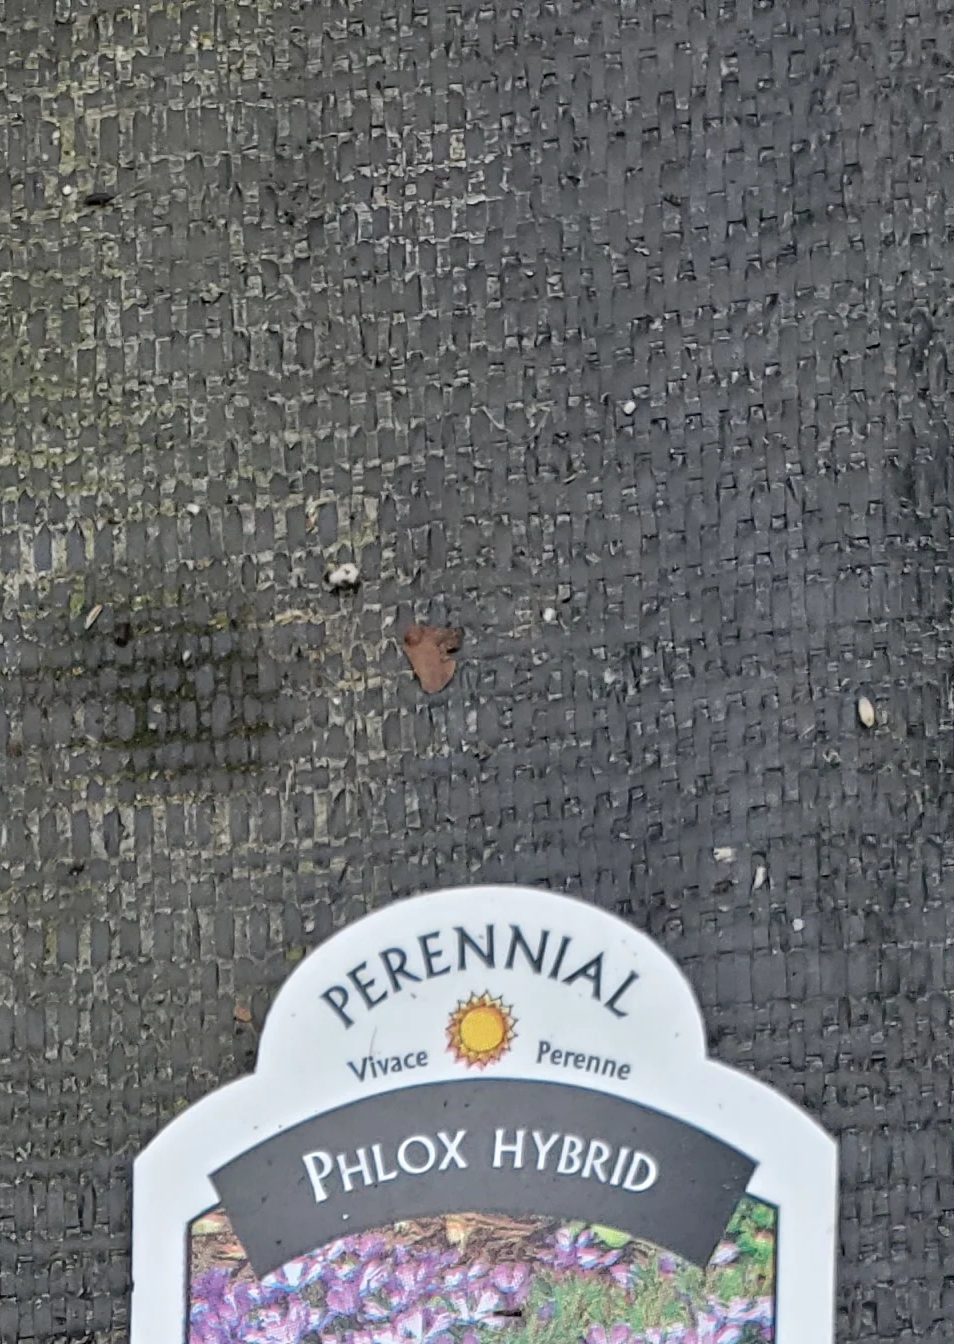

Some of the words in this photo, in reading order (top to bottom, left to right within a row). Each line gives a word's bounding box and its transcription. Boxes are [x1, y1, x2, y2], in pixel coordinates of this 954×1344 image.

[320, 924, 640, 1030] PERENNIAL
[347, 1049, 429, 1082] Vivace
[536, 1041, 632, 1081] Perenne
[302, 1129, 469, 1203] PHLOX
[492, 1129, 658, 1193] HYBRID
